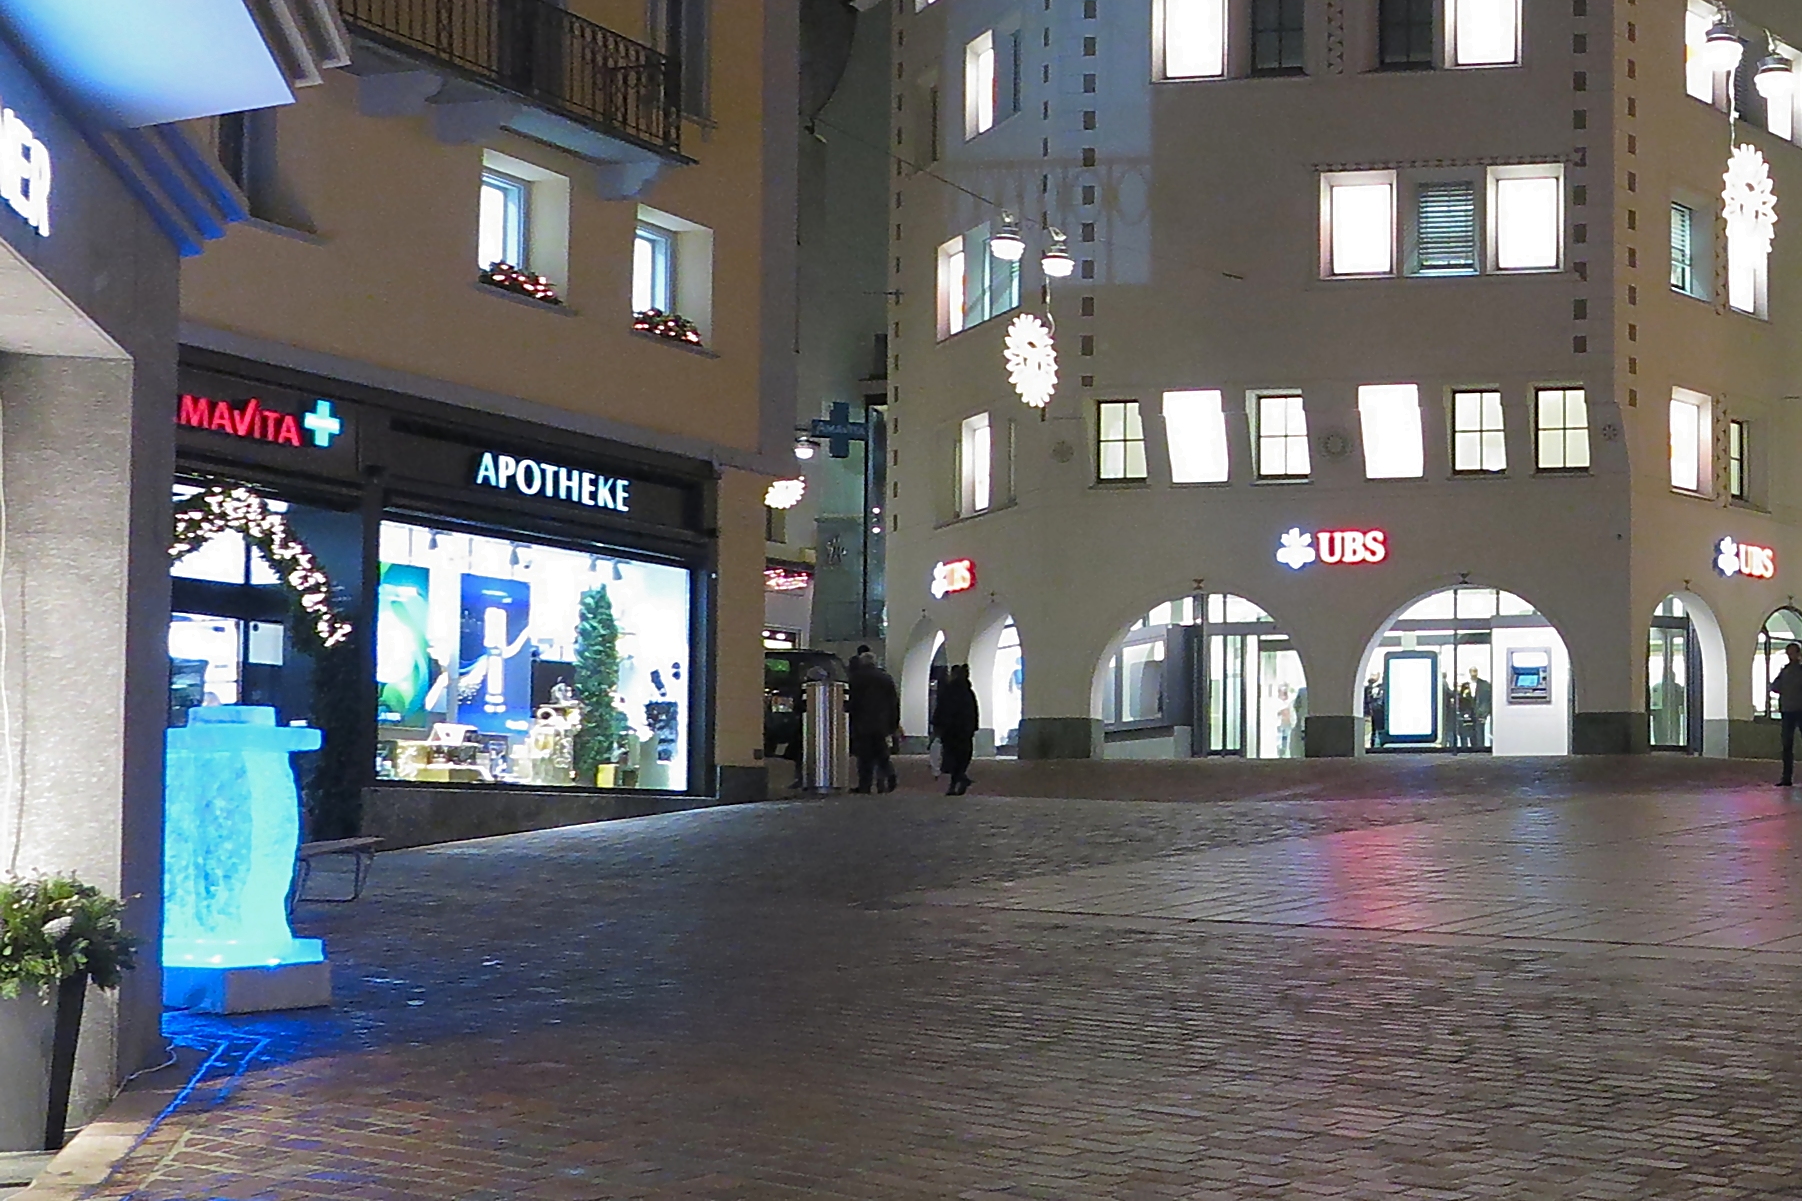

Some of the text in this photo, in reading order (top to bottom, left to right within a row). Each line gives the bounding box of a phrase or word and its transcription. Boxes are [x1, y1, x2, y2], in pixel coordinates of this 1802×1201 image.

[173, 393, 302, 448] MAVITA
[476, 451, 631, 513] APOTHEKE
[1316, 530, 1386, 564] UBS
[1738, 543, 1775, 578] UBS
